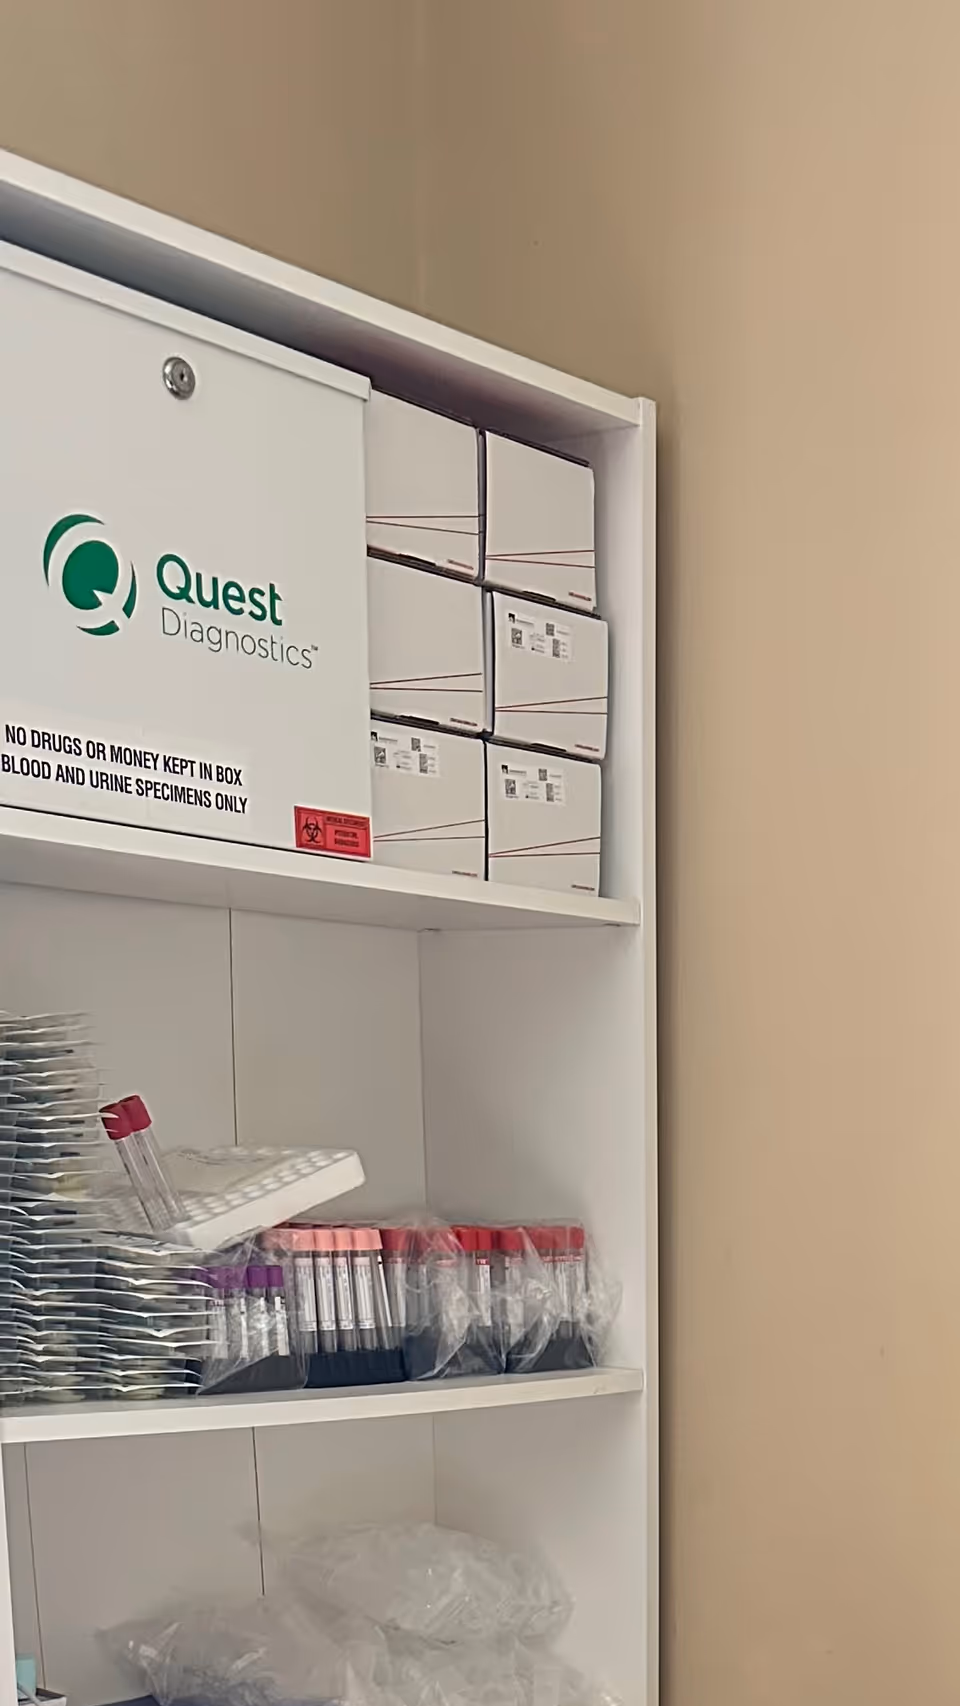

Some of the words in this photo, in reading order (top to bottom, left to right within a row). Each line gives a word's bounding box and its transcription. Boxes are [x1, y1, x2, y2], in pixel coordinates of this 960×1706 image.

[156, 553, 284, 626] Quest
[1, 754, 51, 780] BLOOD
[55, 764, 85, 786] AND
[89, 769, 133, 794] URINE
[135, 778, 212, 809] SPECIMENS
[215, 792, 248, 814] ONLY
[5, 724, 27, 746] NO
[30, 729, 82, 757] DRUGS
[86, 740, 106, 761] OR
[110, 744, 160, 771] MONEY
[163, 755, 196, 778] KEPT
[199, 762, 213, 782] IN
[216, 765, 243, 786] BOX
